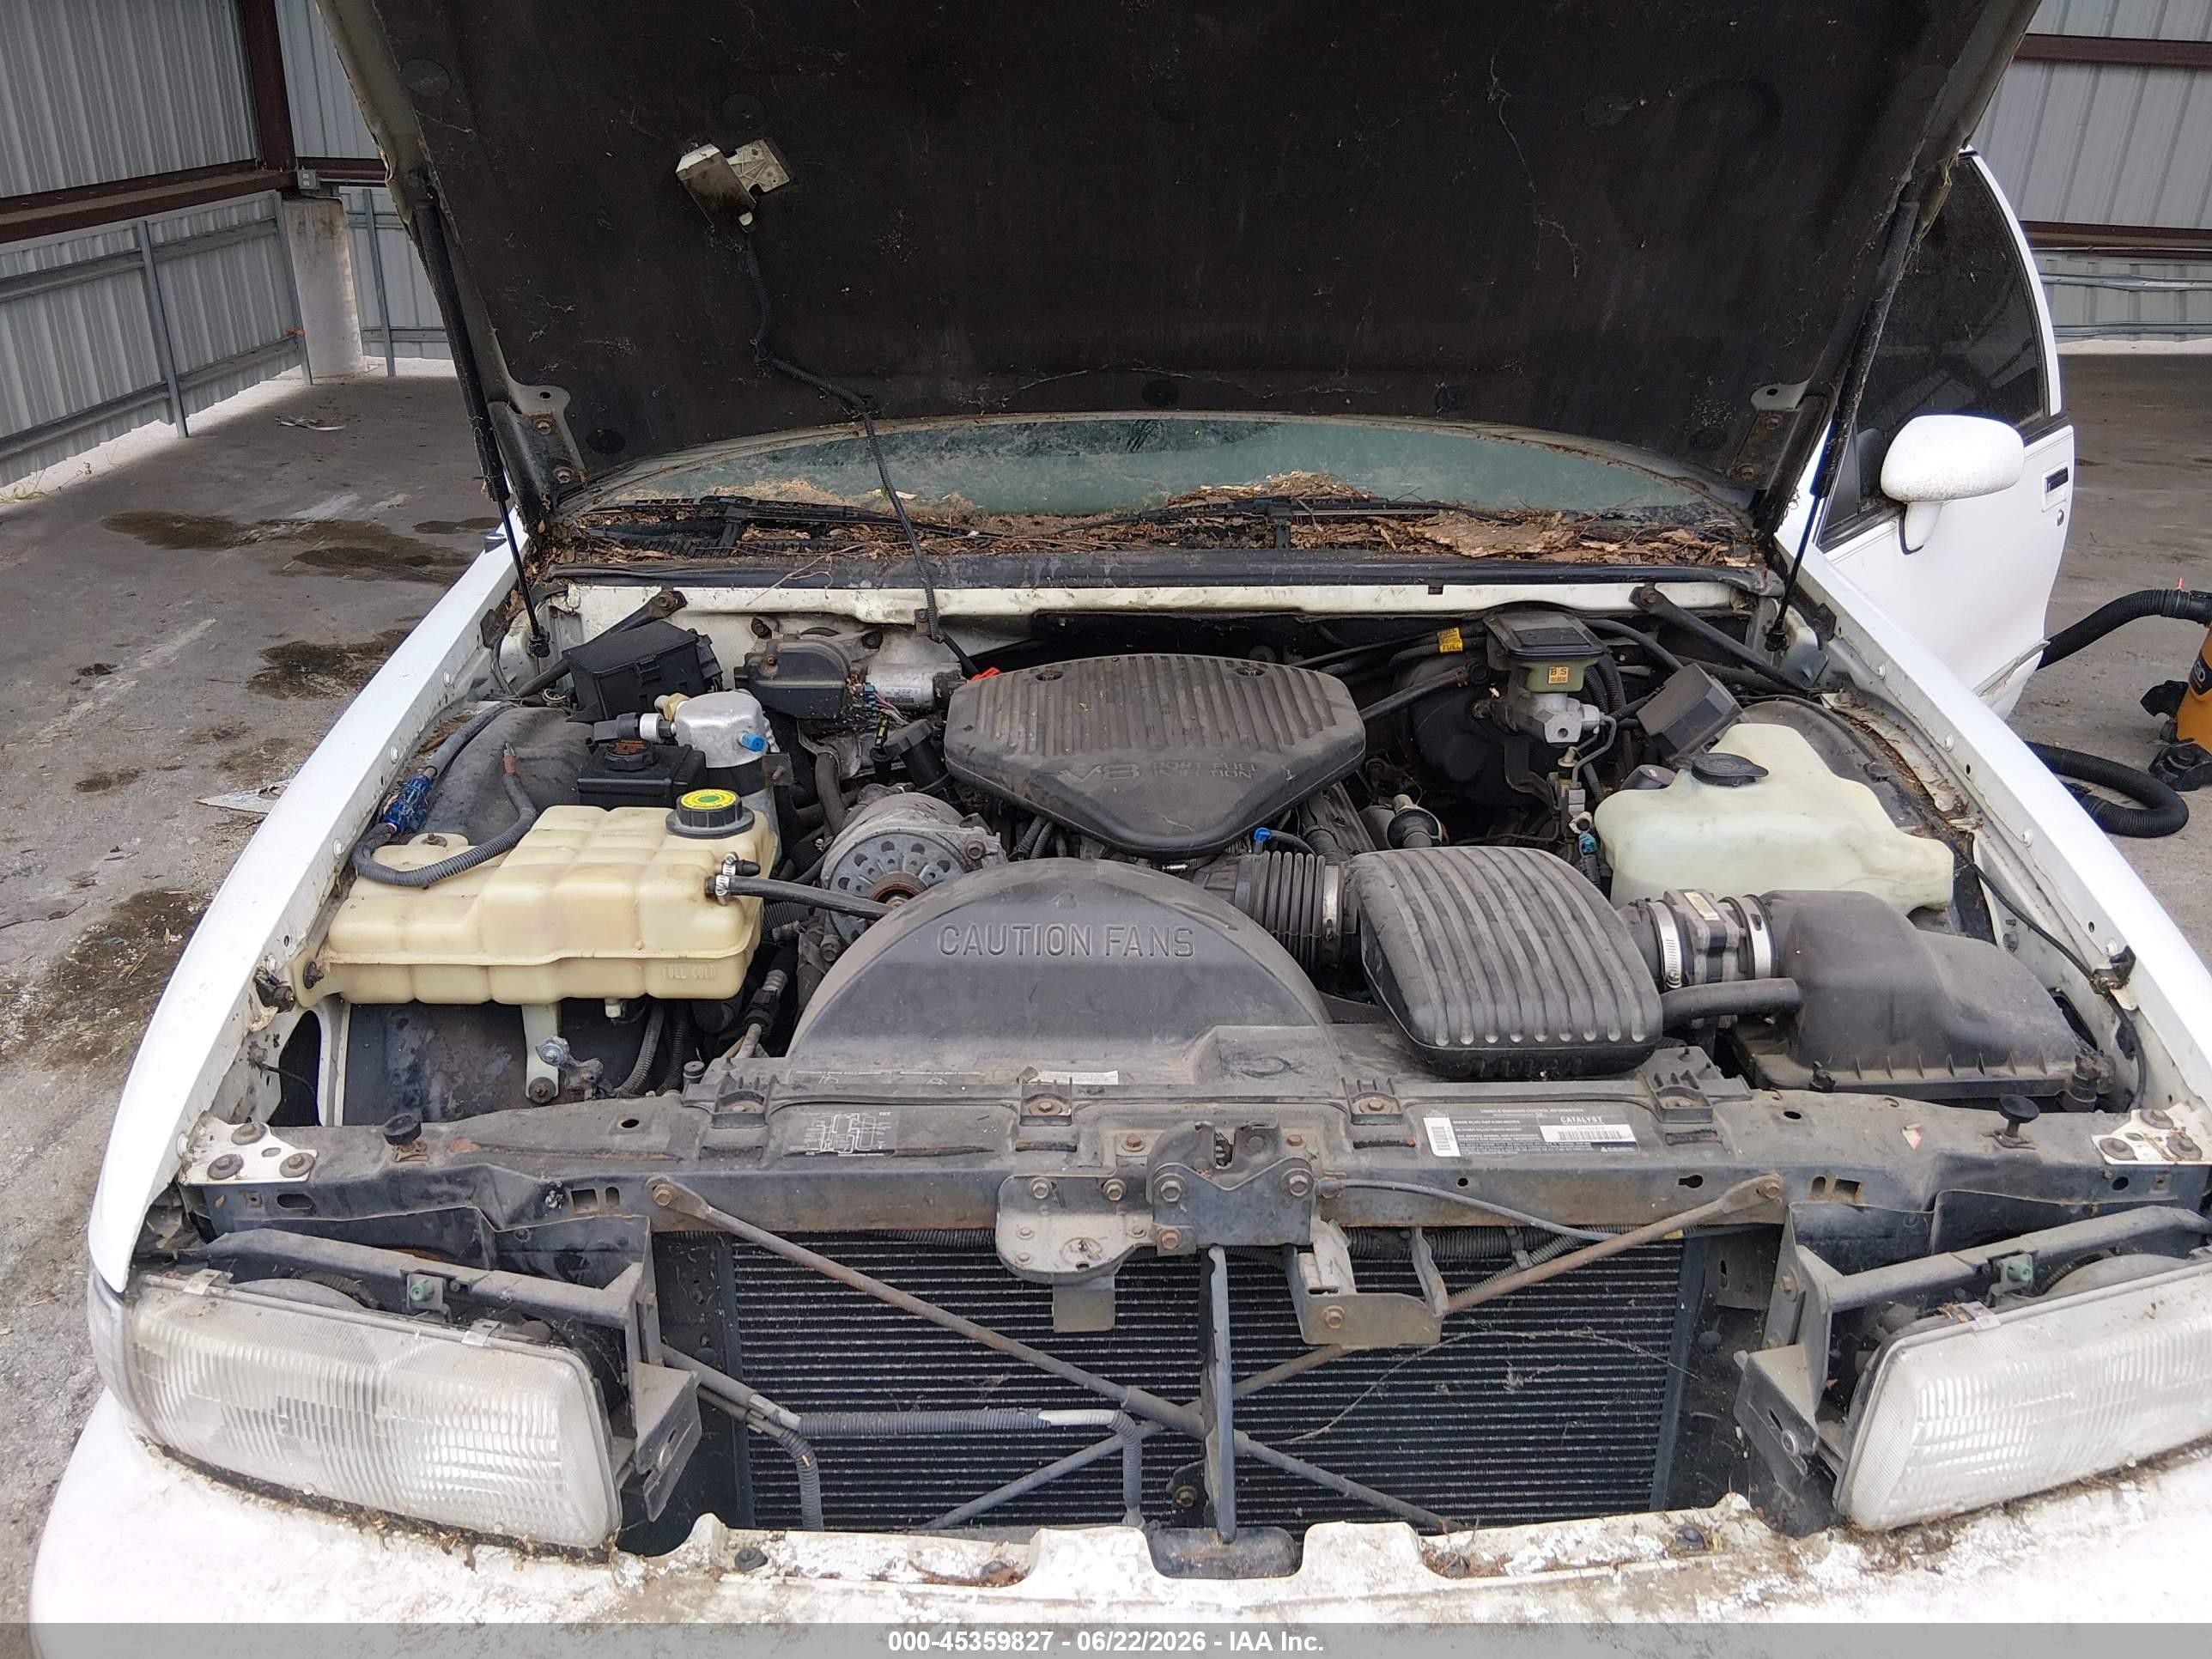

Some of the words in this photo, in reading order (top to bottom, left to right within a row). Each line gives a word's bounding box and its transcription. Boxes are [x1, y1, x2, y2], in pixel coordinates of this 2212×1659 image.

[1057, 763, 1142, 783] V8
[938, 923, 1092, 957] CAUTION
[1104, 924, 1195, 957] FANS
